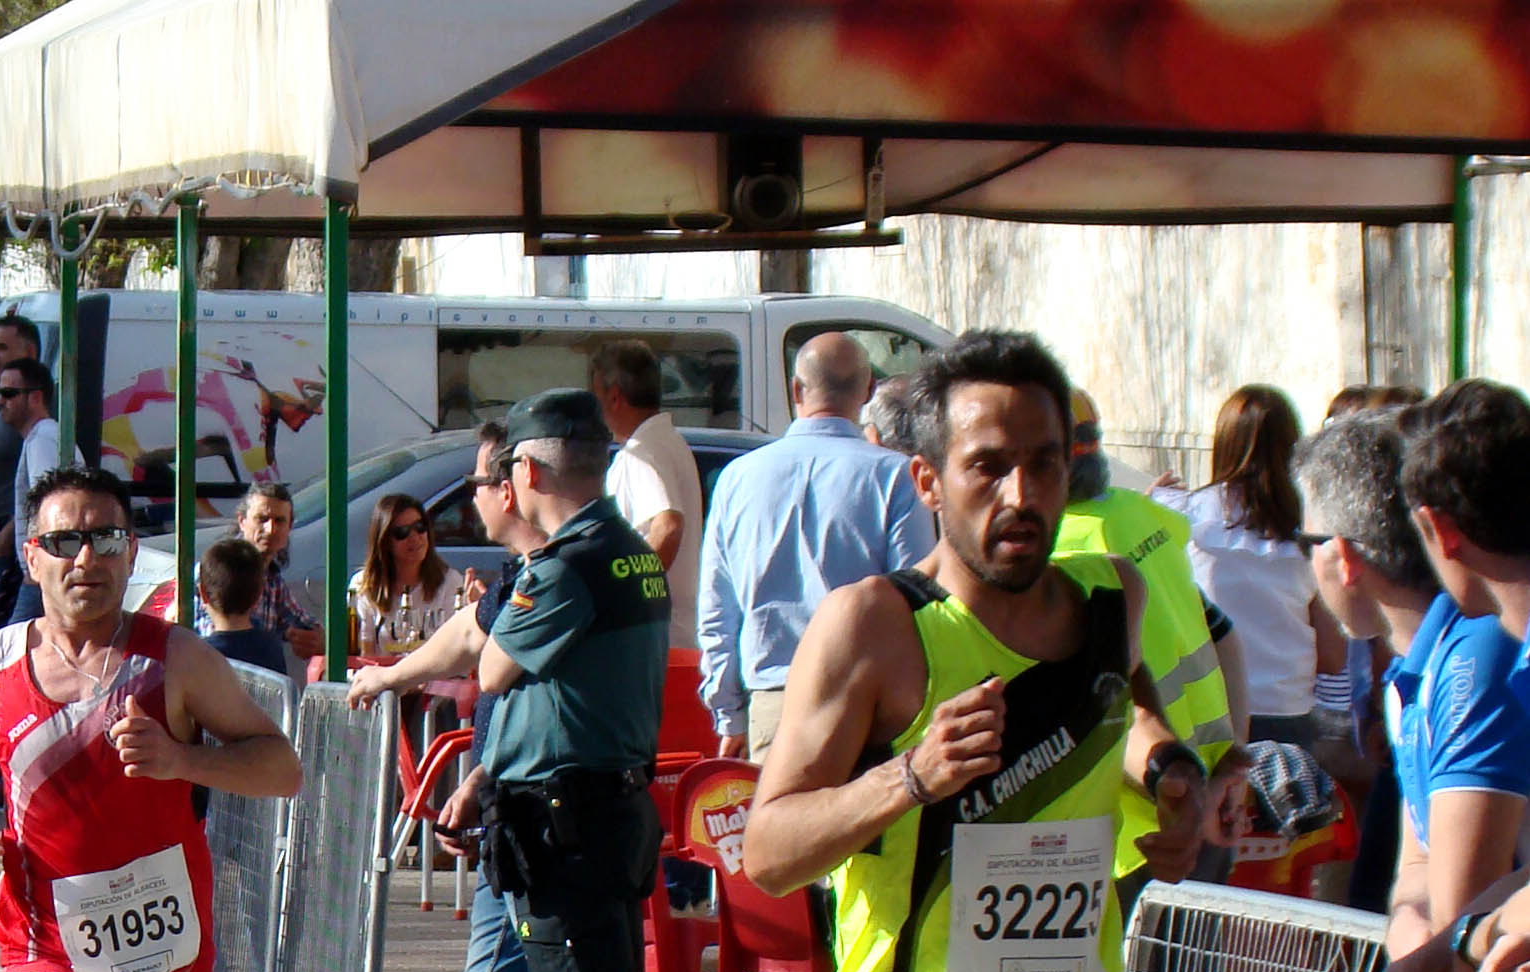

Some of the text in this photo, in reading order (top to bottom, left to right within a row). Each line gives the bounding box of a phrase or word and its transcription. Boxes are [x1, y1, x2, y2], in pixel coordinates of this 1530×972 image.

[643, 577, 667, 598] CIVIL
[991, 726, 1077, 805] CHINCHILLA
[1047, 858, 1059, 867] DE
[124, 891, 133, 900] DE
[134, 878, 168, 896] ALBACETE
[78, 895, 185, 958] 31953
[973, 880, 1104, 941] 32225
